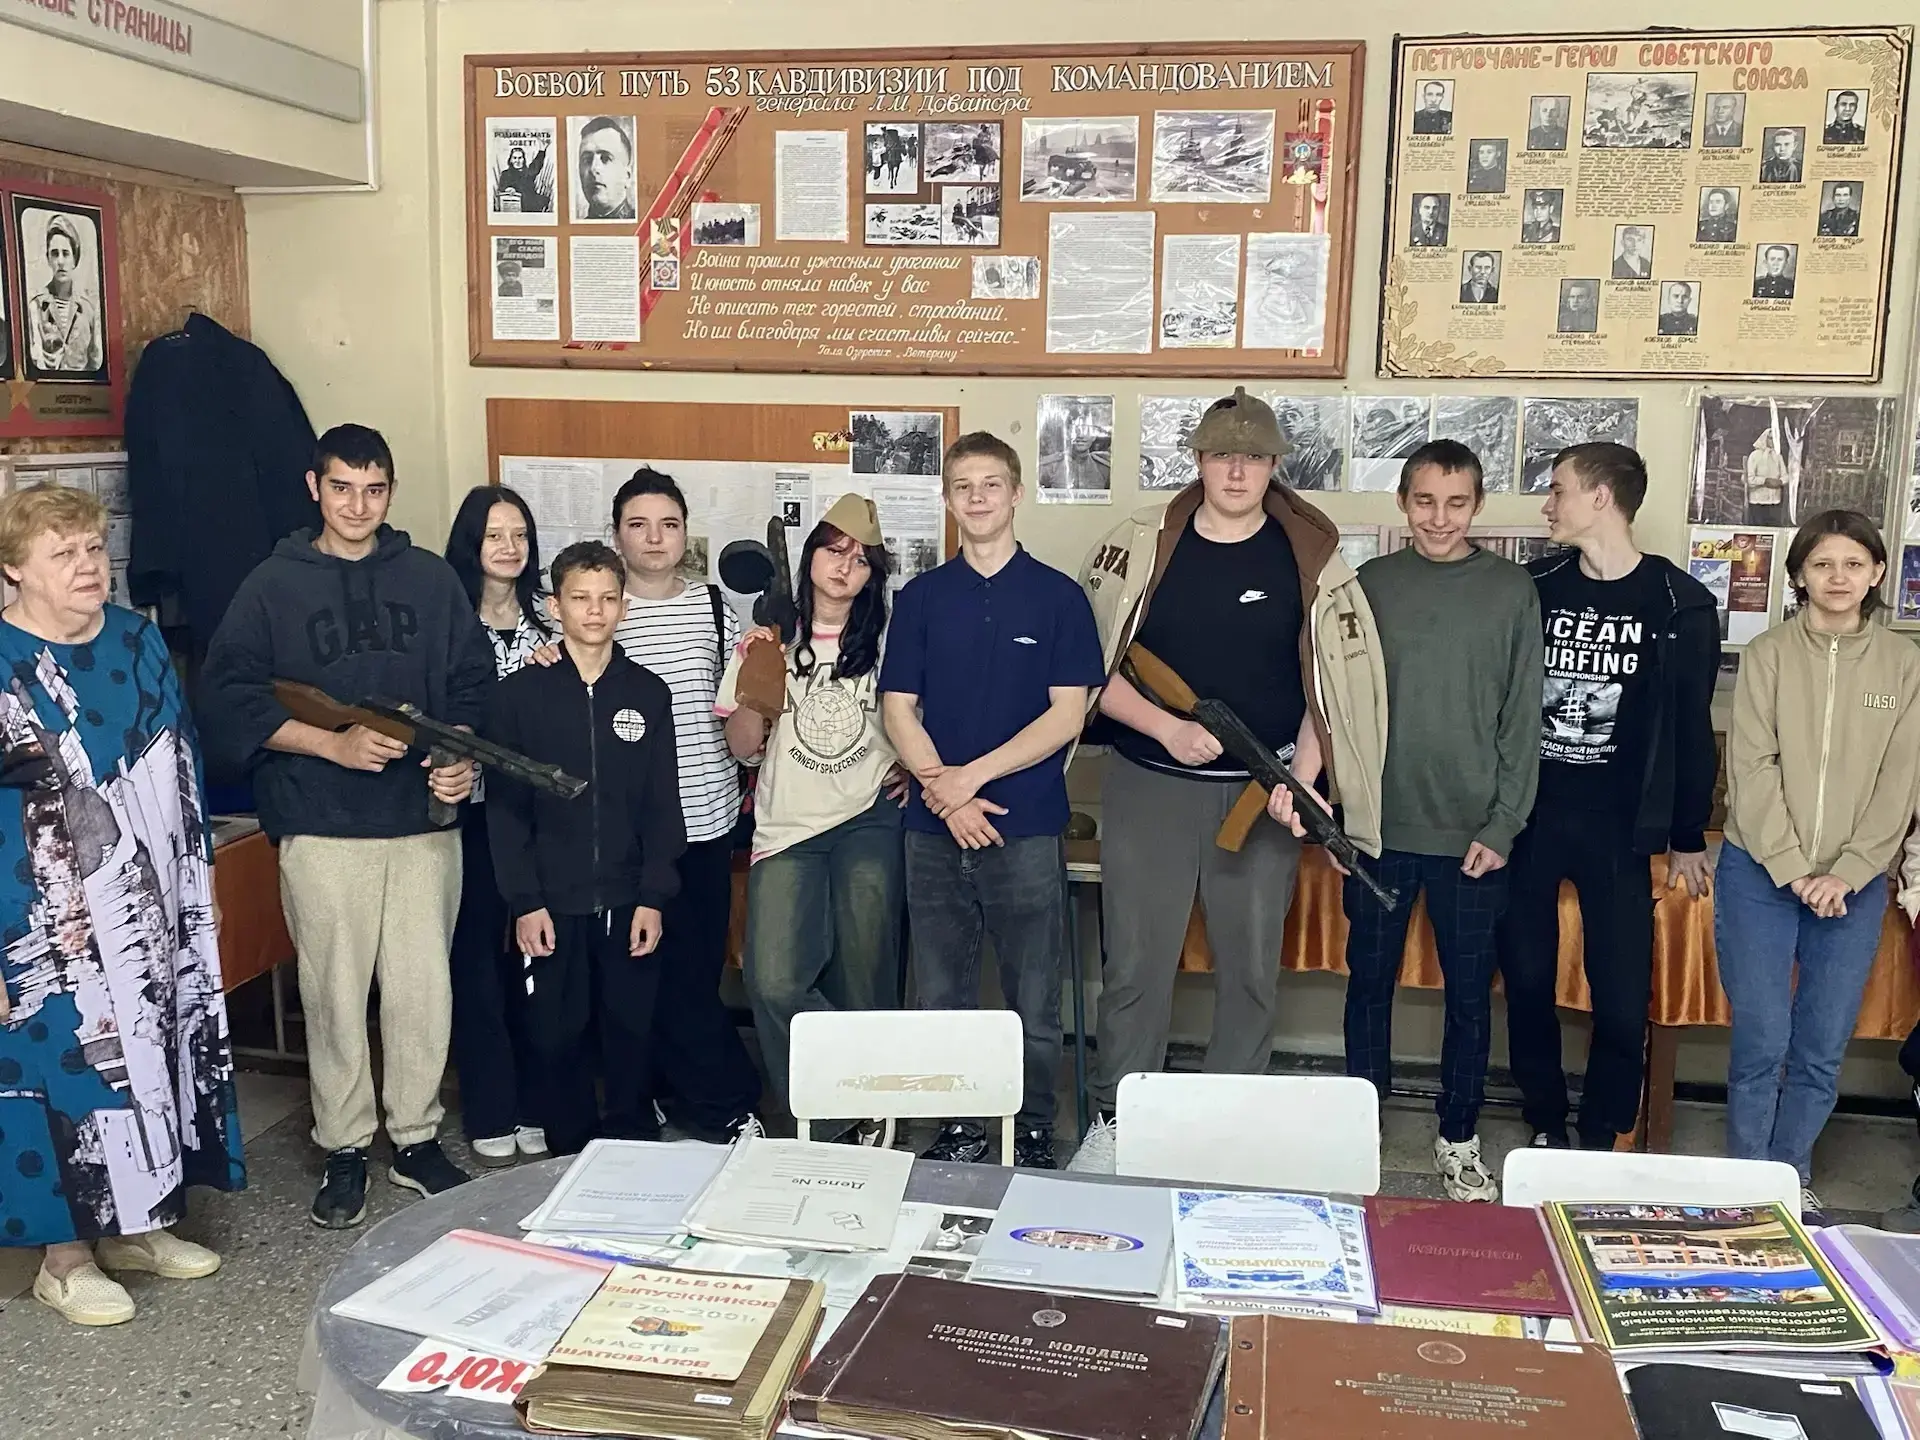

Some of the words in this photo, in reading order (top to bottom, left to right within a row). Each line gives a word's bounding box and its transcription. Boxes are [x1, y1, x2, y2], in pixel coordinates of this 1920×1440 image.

[87, 0, 192, 55] СТРАНИЦЫ
[1639, 41, 1773, 66] СОВЕТСКОГО
[494, 65, 605, 97] БОЕВОЙ
[620, 70, 691, 99] ПУТЬ
[705, 67, 741, 97] 53
[747, 66, 948, 98] КАВДИВИЗИИ
[967, 66, 1023, 97] ПОД
[1051, 61, 1336, 94] КОМАНДОВАНИЕМ
[1733, 67, 1808, 90] СОЮЗА
[756, 96, 858, 119] генерала
[917, 93, 1033, 117] Доватора
[745, 255, 800, 274] прошла
[802, 255, 884, 275] ужасным
[882, 256, 962, 276] ураганом
[690, 272, 703, 292] И
[704, 278, 757, 292] юность
[761, 278, 823, 292] отняла
[827, 272, 872, 293] навек
[874, 279, 894, 301] у
[901, 274, 930, 293] вас
[687, 295, 711, 315] Не
[714, 301, 779, 316] описать
[782, 302, 817, 315] тех
[682, 319, 709, 339] Но
[711, 325, 732, 339] им
[737, 319, 821, 348] благодаря
[826, 328, 858, 341] мы
[858, 323, 951, 343] счастливы
[817, 344, 843, 356] Галя
[1698, 542, 1713, 558] 9
[1580, 612, 1599, 621] 1956
[306, 600, 418, 667] GAP
[1545, 617, 1643, 644] CEAN
[1544, 646, 1639, 675] URFING
[1549, 669, 1610, 682] CHAMPIONSHIP
[788, 745, 820, 772] KENNEDY
[820, 760, 842, 775] SPACE
[842, 745, 868, 769] CENTER
[820, 1178, 865, 1189] Дело
[1201, 1257, 1326, 1268] БЛАГОДАРНОСТЬ
[631, 1273, 753, 1292] АЛЬБОМ
[602, 1284, 777, 1308] ВЫПУСКНИКОВ
[1611, 1309, 1671, 1318] колледж
[1621, 1316, 1725, 1326] региональный
[1730, 1316, 1848, 1325] Светлоградский
[583, 1336, 700, 1353] МАСТЕР
[1048, 1341, 1149, 1363] МОЛОДЕЖЬ
[554, 1347, 711, 1368] ШАПОВАЛОВ
[407, 1352, 525, 1394] КОГО
